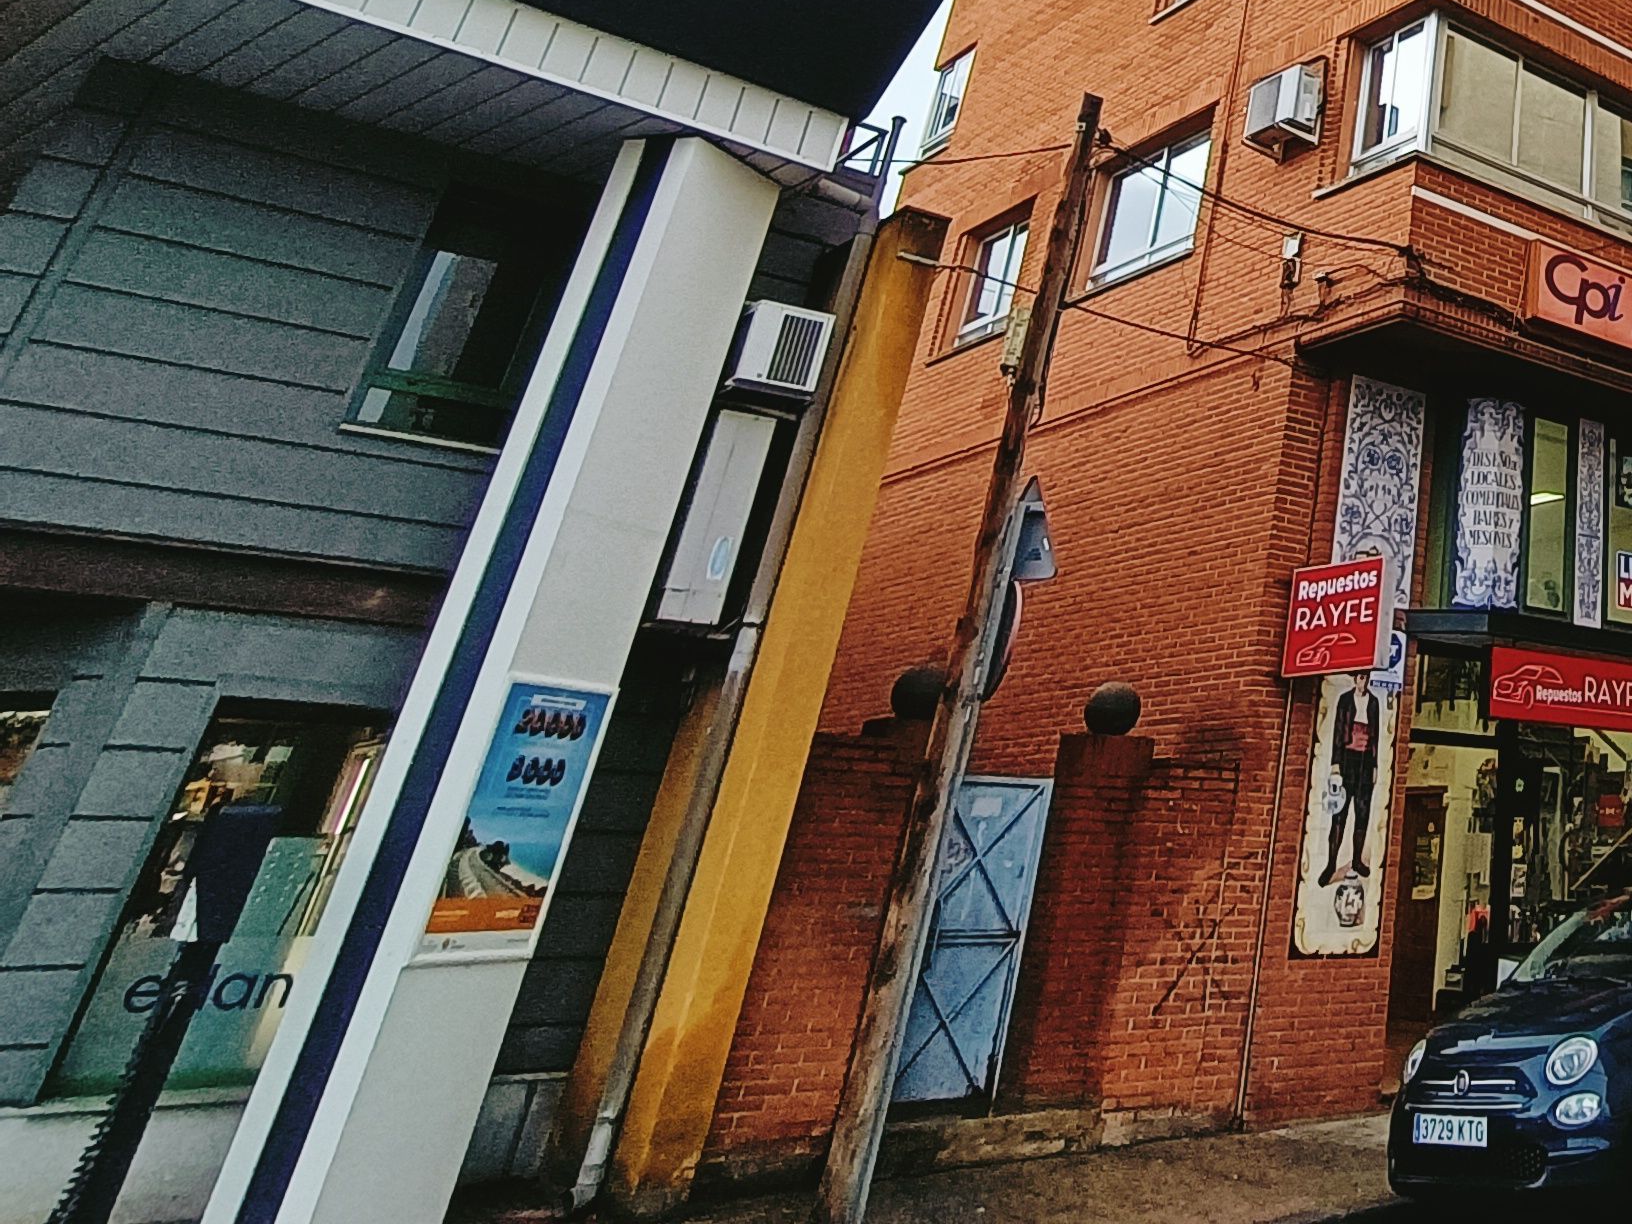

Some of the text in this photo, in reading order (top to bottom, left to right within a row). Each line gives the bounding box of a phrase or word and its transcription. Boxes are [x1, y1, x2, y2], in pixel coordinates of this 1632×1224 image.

[1298, 570, 1378, 602] Repuestos
[1295, 597, 1375, 632] RAYFE
[1535, 685, 1583, 706] Repuestos
[1422, 1117, 1484, 1143] 3729 KTG
